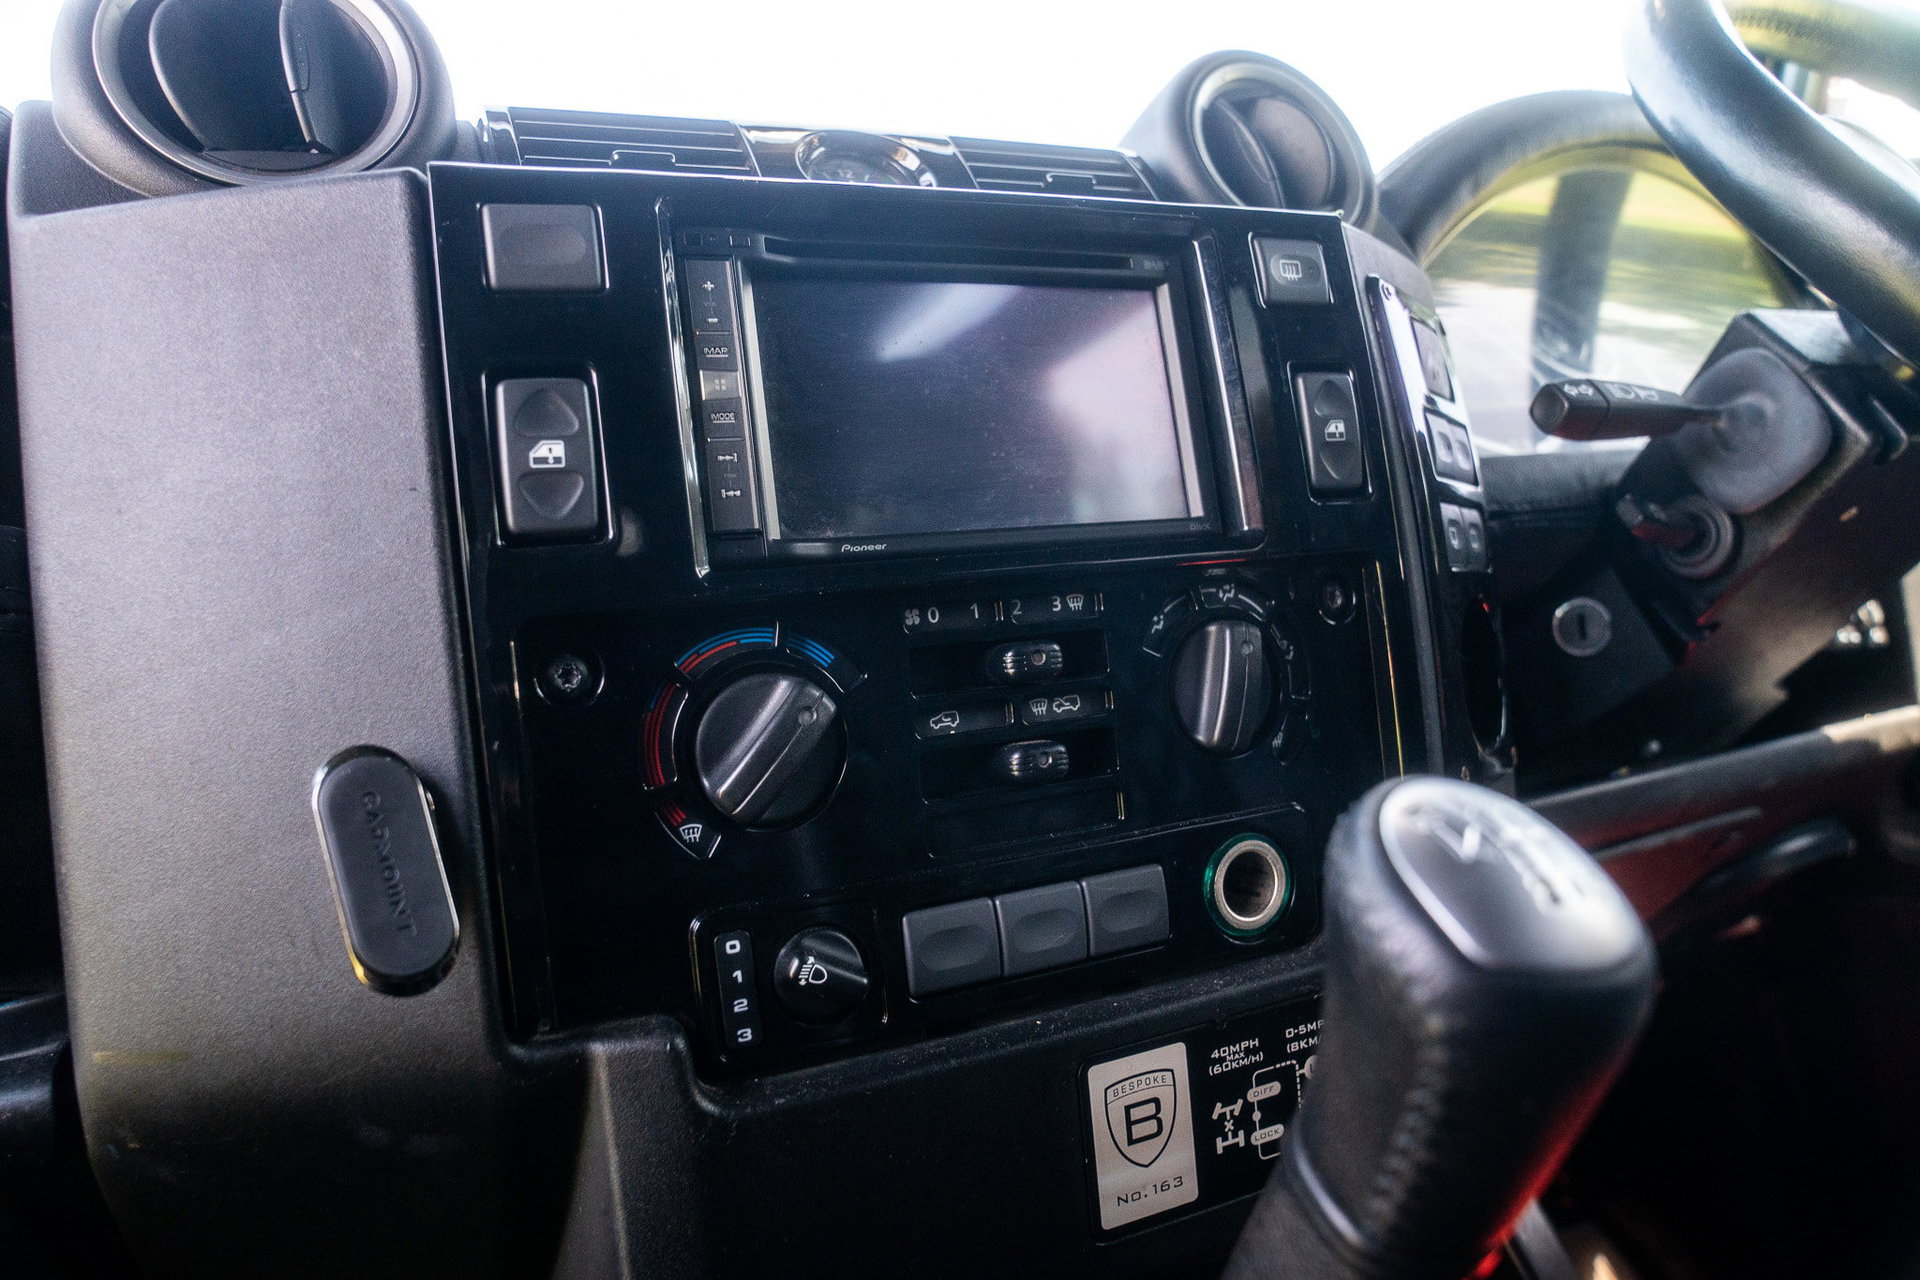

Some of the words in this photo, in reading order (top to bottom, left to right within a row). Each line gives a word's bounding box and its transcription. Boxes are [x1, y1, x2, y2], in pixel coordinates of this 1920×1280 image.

[703, 346, 728, 355] MAP
[710, 412, 735, 421] MODE
[841, 542, 888, 553] Pioneer
[927, 607, 940, 624] 0
[970, 602, 979, 619] 1
[1011, 599, 1022, 615] 2
[1052, 595, 1062, 612] 3
[725, 939, 741, 955] 0
[732, 969, 743, 983] 1
[733, 998, 749, 1013] 2
[736, 1027, 752, 1043] 3
[1285, 1019, 1325, 1039] 0-5MP
[1211, 1038, 1260, 1060] 40MPH
[1226, 1051, 1246, 1062] MAX
[1208, 1051, 1264, 1077] (60KM/H)
[1112, 1074, 1168, 1098] BESPOKE
[1252, 1085, 1275, 1098] DIFF
[1123, 1096, 1164, 1147] B
[1254, 1127, 1280, 1142] LOCK
